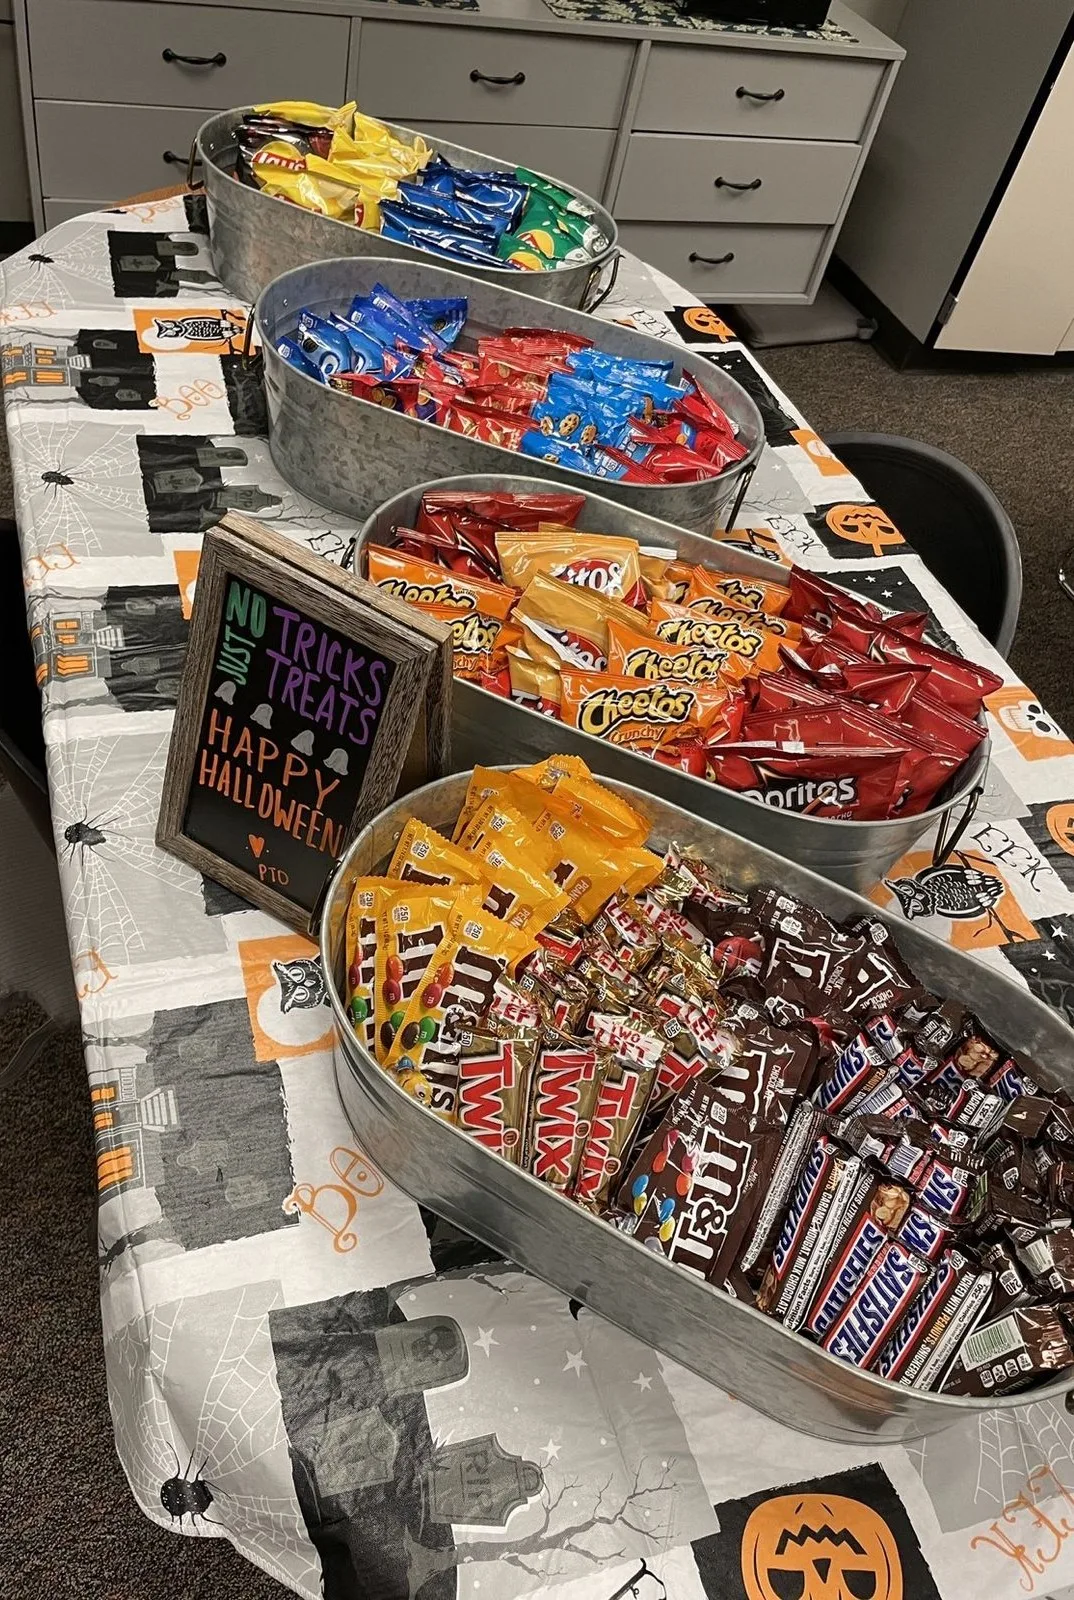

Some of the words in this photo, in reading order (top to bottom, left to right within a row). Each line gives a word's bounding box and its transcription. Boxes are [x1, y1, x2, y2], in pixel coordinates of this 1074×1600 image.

[764, 516, 824, 556] EEK
[226, 581, 267, 638] NO
[273, 606, 387, 707] TRICKS
[656, 619, 763, 658] Cheetos
[216, 624, 256, 686] JUST
[266, 649, 377, 746] TREATS
[577, 684, 697, 737] Cheetos
[208, 708, 340, 809] HAPPY
[416, 843, 429, 859] 250
[970, 822, 1054, 892] EEK
[259, 863, 289, 886] PTO
[365, 891, 374, 908] 250
[400, 906, 409, 922] 250
[470, 924, 483, 939] 250
[873, 930, 888, 943] 230
[613, 1023, 641, 1043] TWO
[667, 1021, 681, 1037] 250
[461, 1041, 519, 1153] TWI
[717, 1107, 727, 1124] 230
[795, 1255, 806, 1274] MILK
[775, 1271, 801, 1315] CHOCOLATE
[798, 1278, 812, 1299] Facts
[971, 1283, 984, 1299] 250
[1008, 1281, 1022, 1296] 240
[944, 1297, 959, 1317] WITH
[924, 1306, 951, 1344] PEANUTS,
[907, 1344, 932, 1379] SNICKERS
